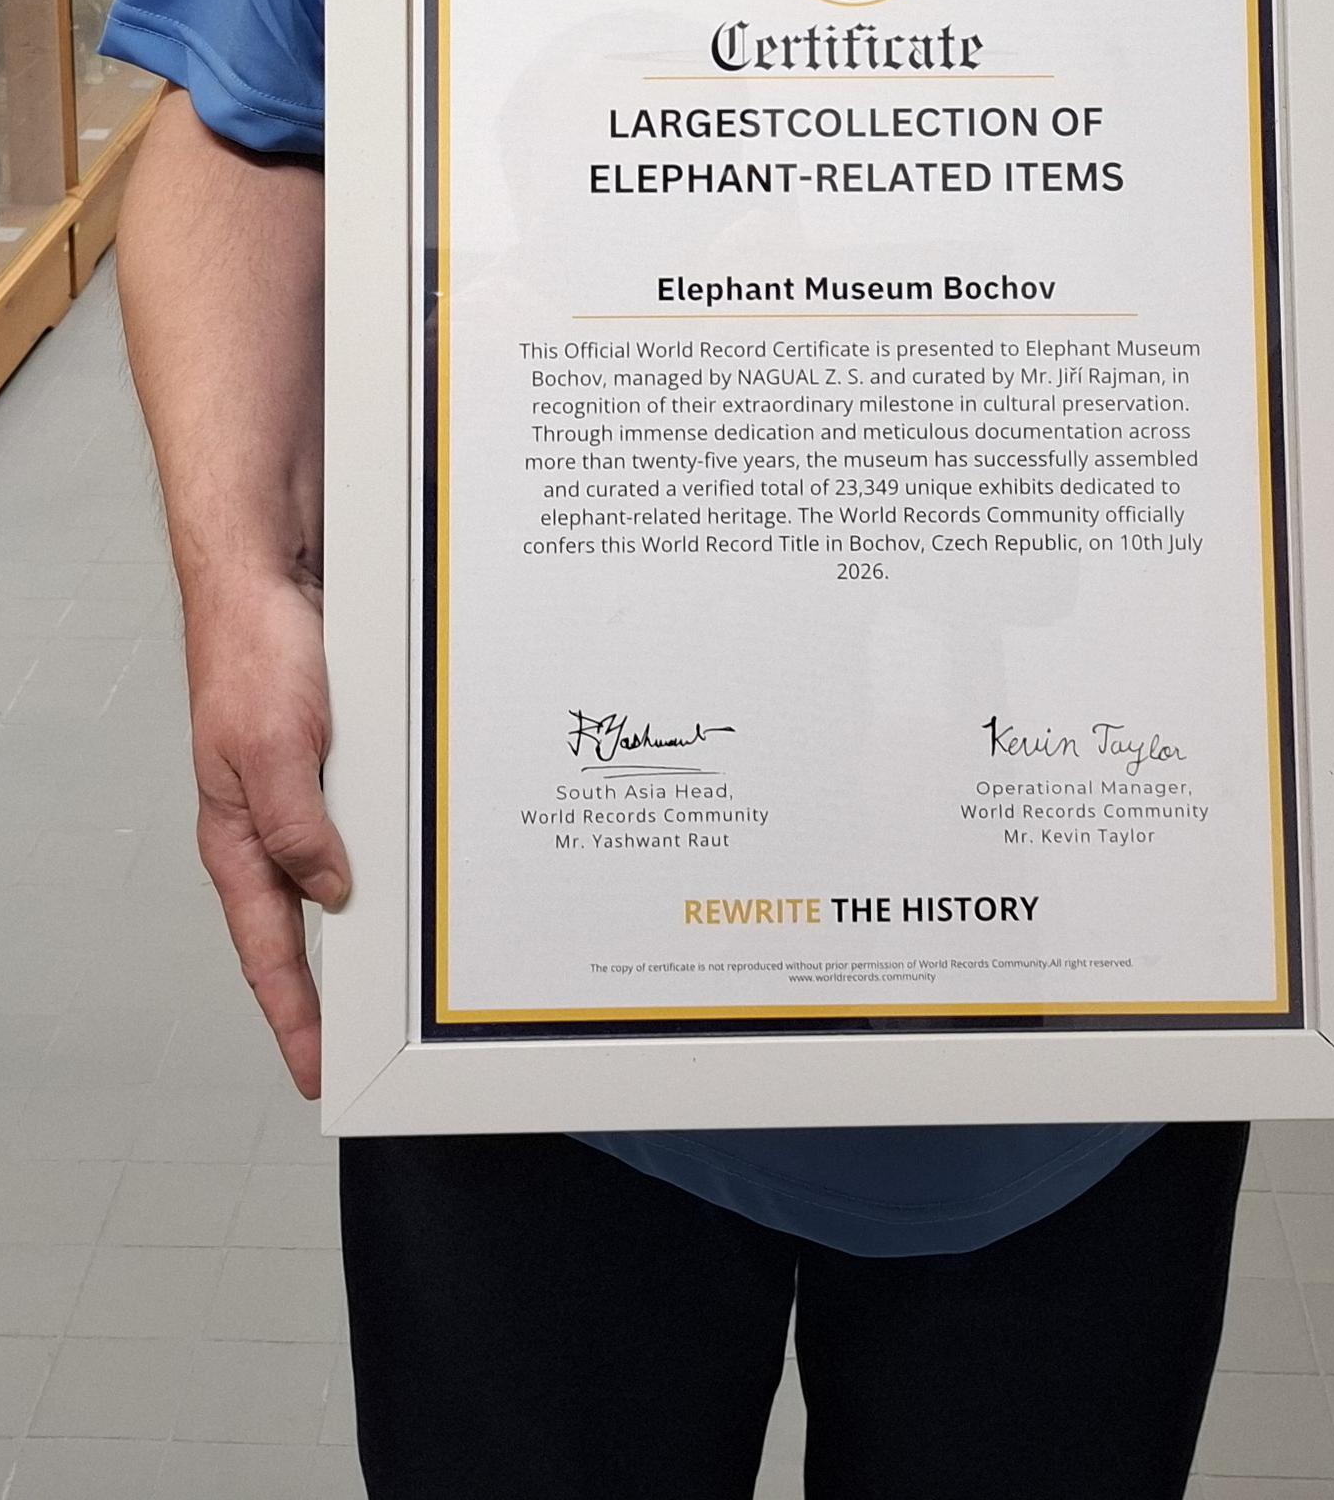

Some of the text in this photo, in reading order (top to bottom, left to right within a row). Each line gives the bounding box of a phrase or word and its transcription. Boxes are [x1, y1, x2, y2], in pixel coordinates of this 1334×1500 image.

[710, 19, 984, 72] Certificate
[609, 106, 1104, 139] LARGESTCOLLECTION OF
[590, 161, 1124, 194] ELEPHANT-RELATED ITEMS
[657, 274, 1056, 308] Elephant Museum Bochov
[518, 339, 1201, 362] This Official World Record Certificate is presented to Elephant Museum
[532, 366, 1190, 391] Bochov, managed by NAGUAL Z. S. and curated by Mr. Jiří Rajman, in
[532, 394, 1190, 420] recognition of their extraordinary milestone in cultural preservation.
[531, 422, 1191, 447] Through immense dedication and meticulous documentation across
[525, 449, 1198, 474] more than twenty-five years, the museum has successfully assembled
[543, 476, 1181, 501] and curated a verified total of 23,349 unique exhibits dedicated to
[540, 504, 1185, 531] elephant-related heritage. The World Records Community officially
[523, 532, 1204, 557] confers this World Record Title in Bochov, Czech Republic, on 10th July
[836, 562, 889, 581] 2026.
[981, 715, 1187, 776] Kevin Taylor
[555, 782, 733, 801] South Asia Head,
[976, 779, 1192, 799] Operational Manager,
[520, 806, 769, 827] World Records Community
[960, 802, 1209, 822] World Records Community
[555, 832, 730, 850] Mr. Yashwant Raut
[1004, 827, 1156, 848] Mr. Kevin Taylor
[684, 895, 1040, 925] REWRITE THE HISTORY
[589, 963, 609, 974] The
[610, 964, 634, 976] copy
[635, 962, 646, 973] of
[647, 961, 696, 973] certificate
[697, 962, 706, 972] is
[708, 962, 725, 972] not
[726, 960, 784, 974] reproduced
[784, 960, 823, 971] without
[825, 961, 849, 973] prior
[850, 960, 905, 973] permission
[906, 959, 918, 970] of
[918, 959, 949, 970] World
[950, 958, 990, 970] Records
[1064, 958, 1088, 971] right
[787, 971, 937, 984] www.worldrecords.community
